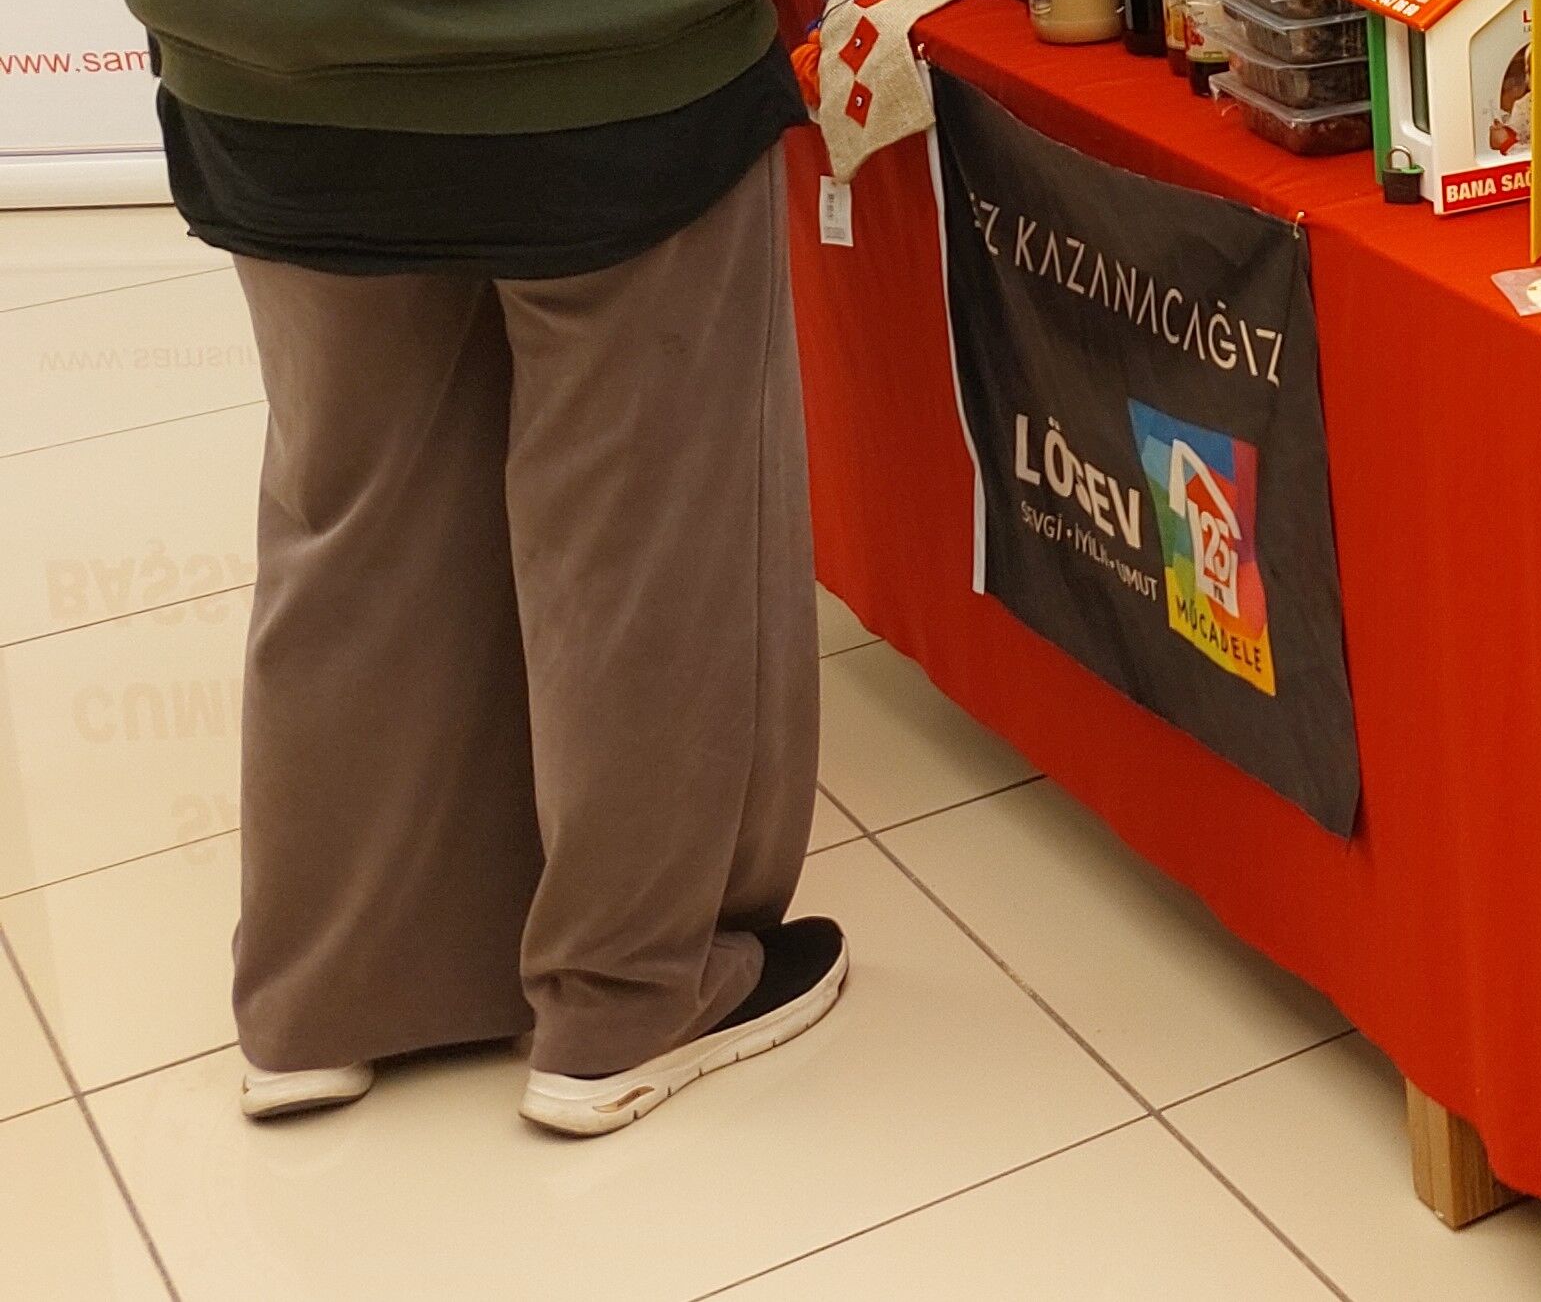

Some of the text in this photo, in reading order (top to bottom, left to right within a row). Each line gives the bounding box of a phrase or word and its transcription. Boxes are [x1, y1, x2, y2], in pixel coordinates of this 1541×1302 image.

[1446, 177, 1497, 203] BANA
[1015, 215, 1283, 388] KAZANACAĞIZ
[1015, 413, 1142, 548] LÖSEV
[1201, 511, 1231, 583] 25
